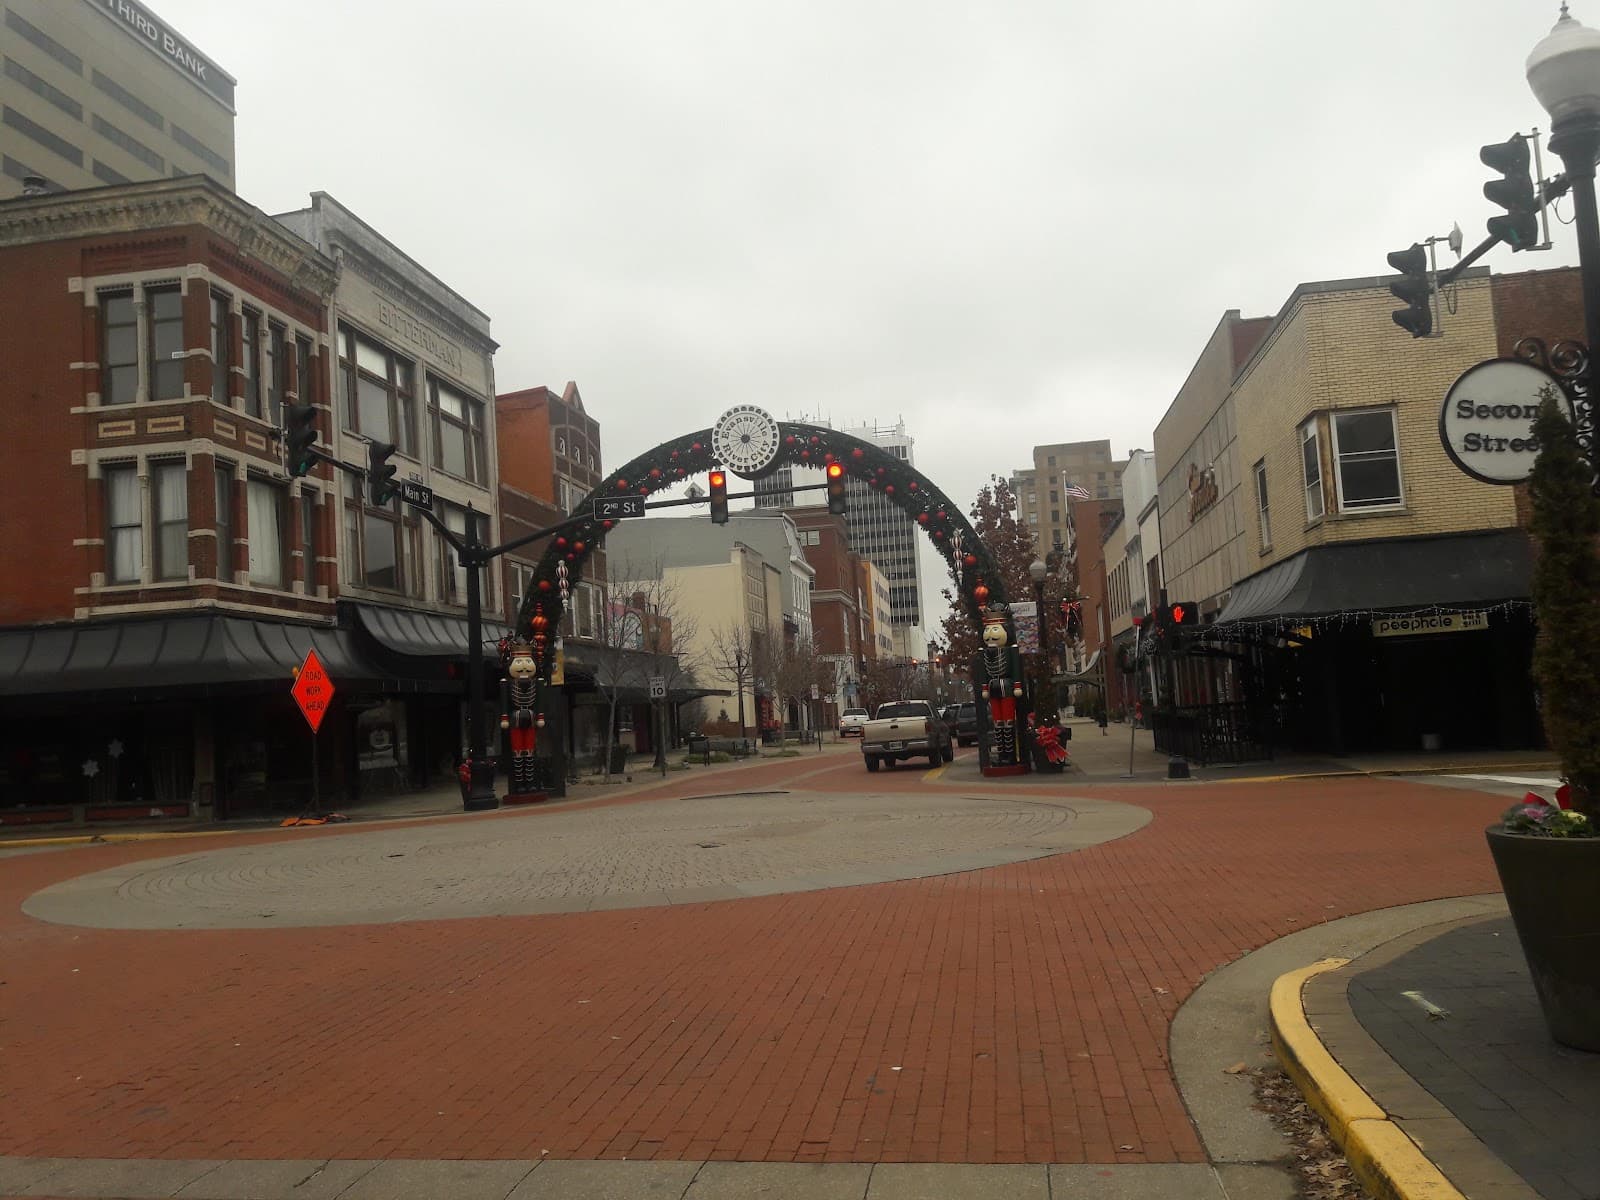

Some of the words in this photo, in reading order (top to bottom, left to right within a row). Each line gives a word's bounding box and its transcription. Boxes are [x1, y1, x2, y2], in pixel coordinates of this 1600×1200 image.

[163, 33, 207, 81] BANK
[1456, 399, 1539, 420] Secon
[1463, 432, 1541, 453] Stree
[404, 484, 420, 502] Main
[421, 491, 429, 505] St
[623, 501, 637, 513] St
[1379, 616, 1453, 633] peephole
[305, 671, 321, 680] ROAD
[306, 687, 321, 697] WORK
[653, 687, 664, 696] 10
[305, 701, 325, 711] AHEAD
